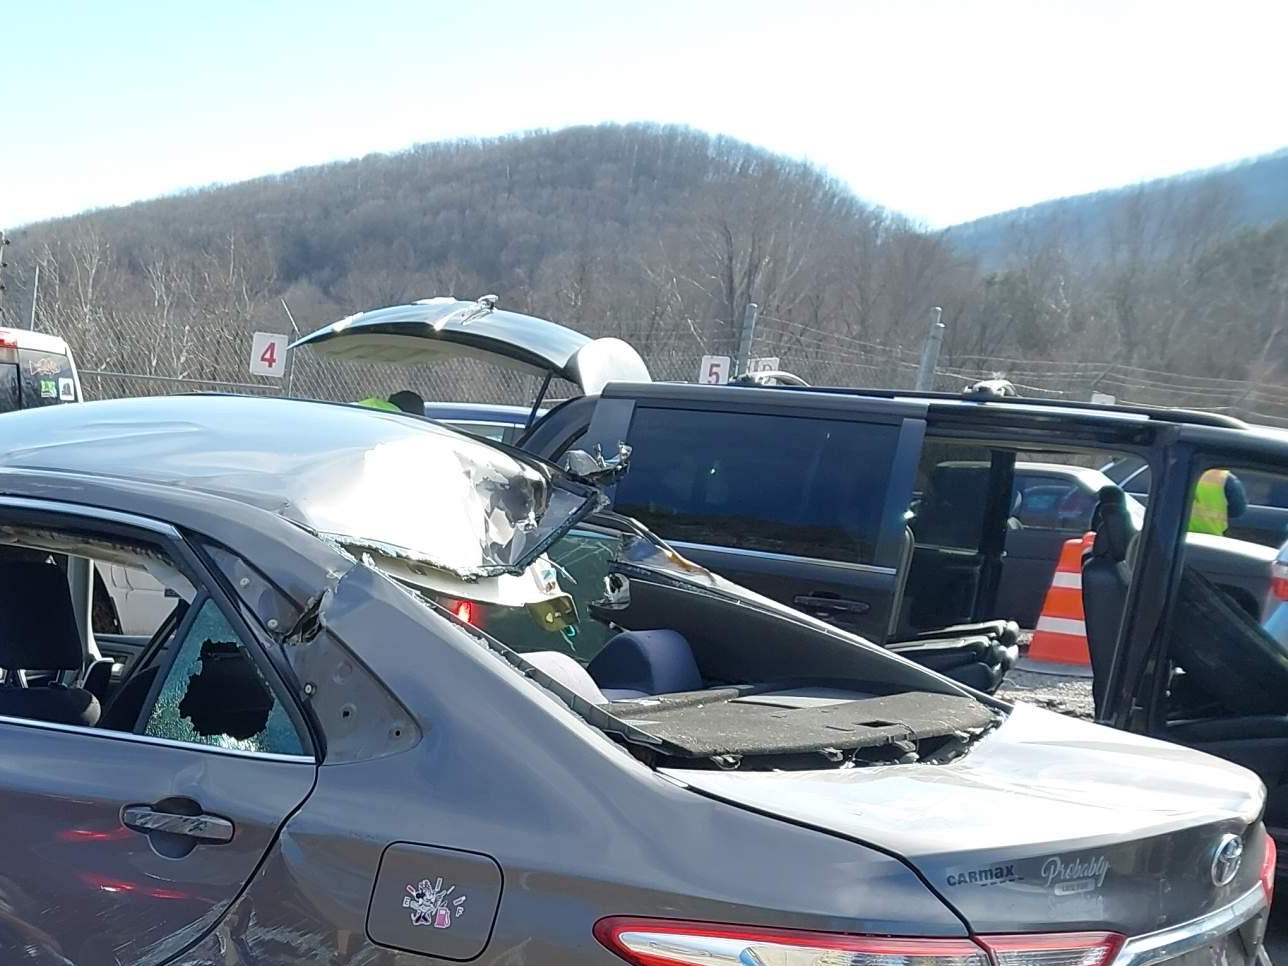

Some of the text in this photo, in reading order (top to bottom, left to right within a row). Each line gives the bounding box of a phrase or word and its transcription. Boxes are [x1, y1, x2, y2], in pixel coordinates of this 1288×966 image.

[260, 342, 276, 368] 4
[708, 363, 721, 384] 5
[1041, 856, 1112, 888] Probably
